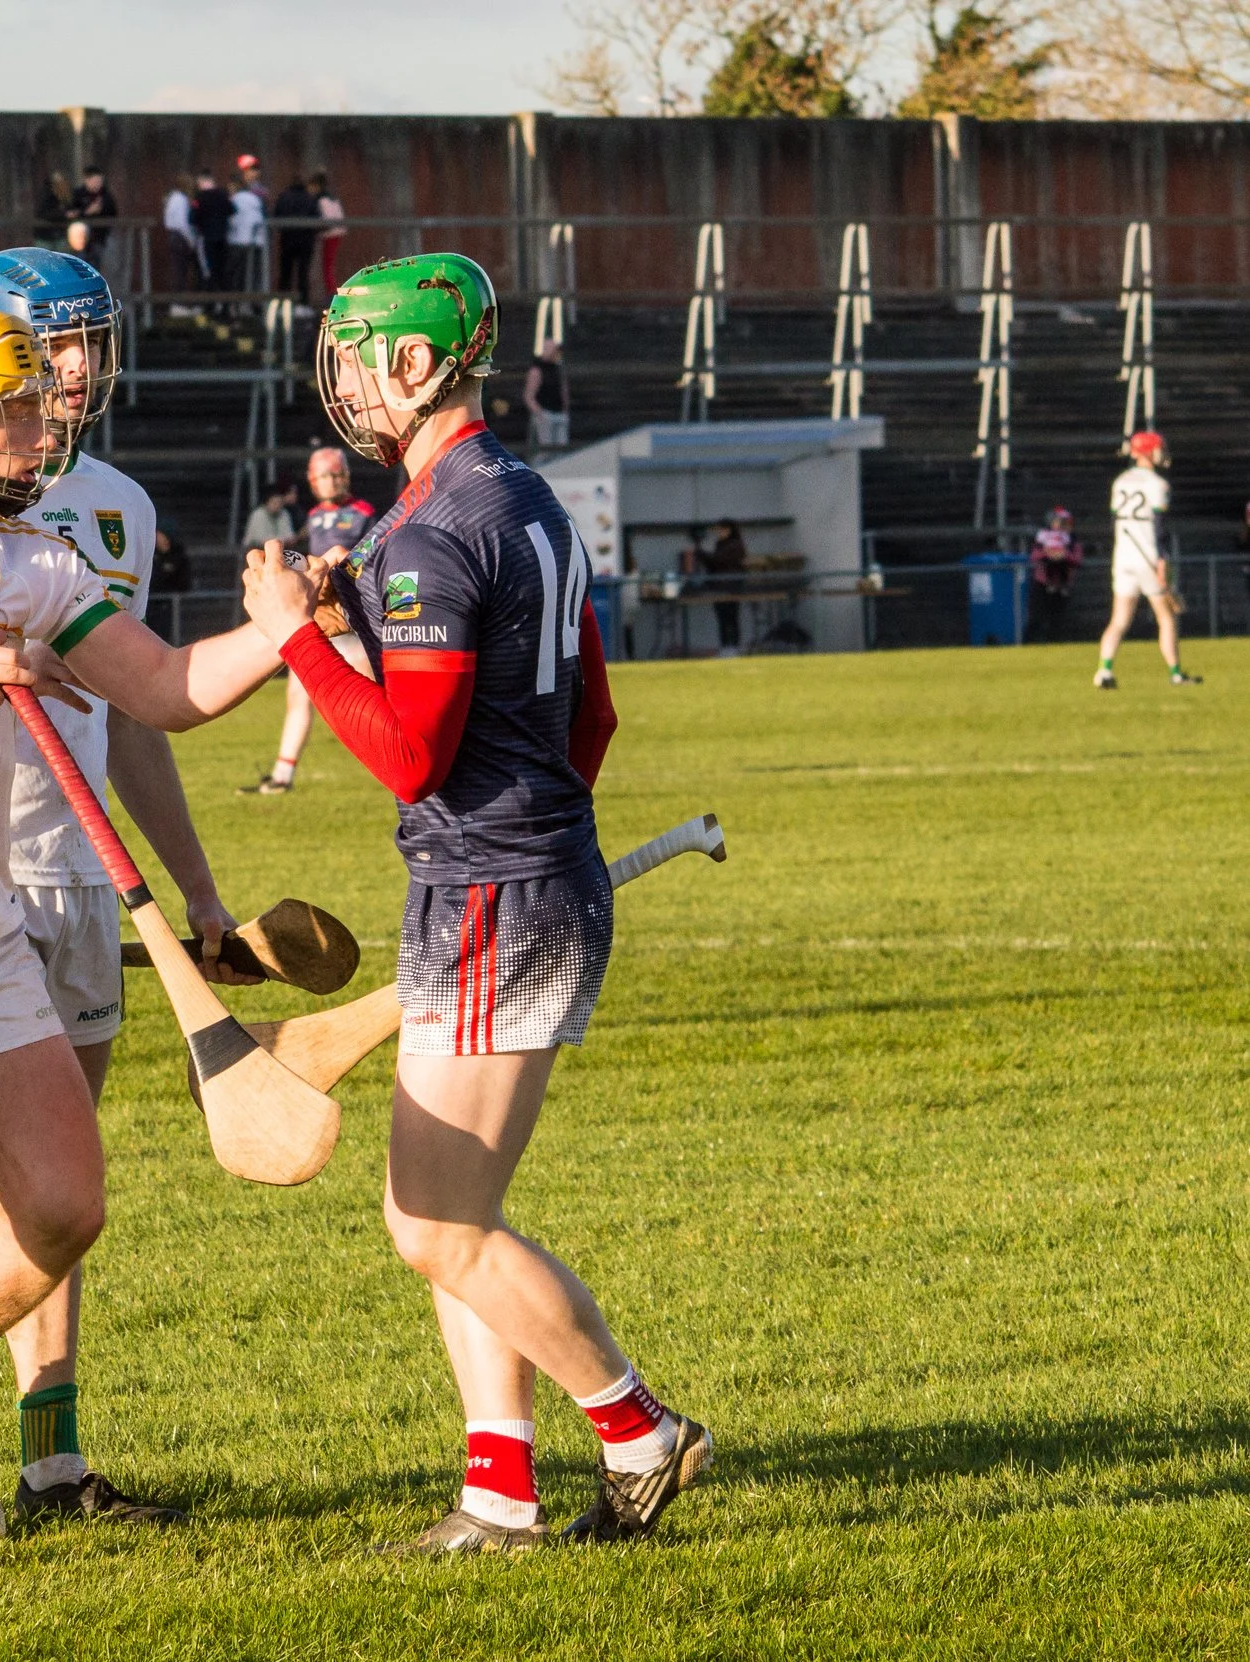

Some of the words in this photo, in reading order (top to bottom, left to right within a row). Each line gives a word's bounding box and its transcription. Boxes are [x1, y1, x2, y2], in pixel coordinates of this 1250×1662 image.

[472, 462, 506, 478] The
[1114, 489, 1151, 521] 22
[524, 519, 588, 695] 14
